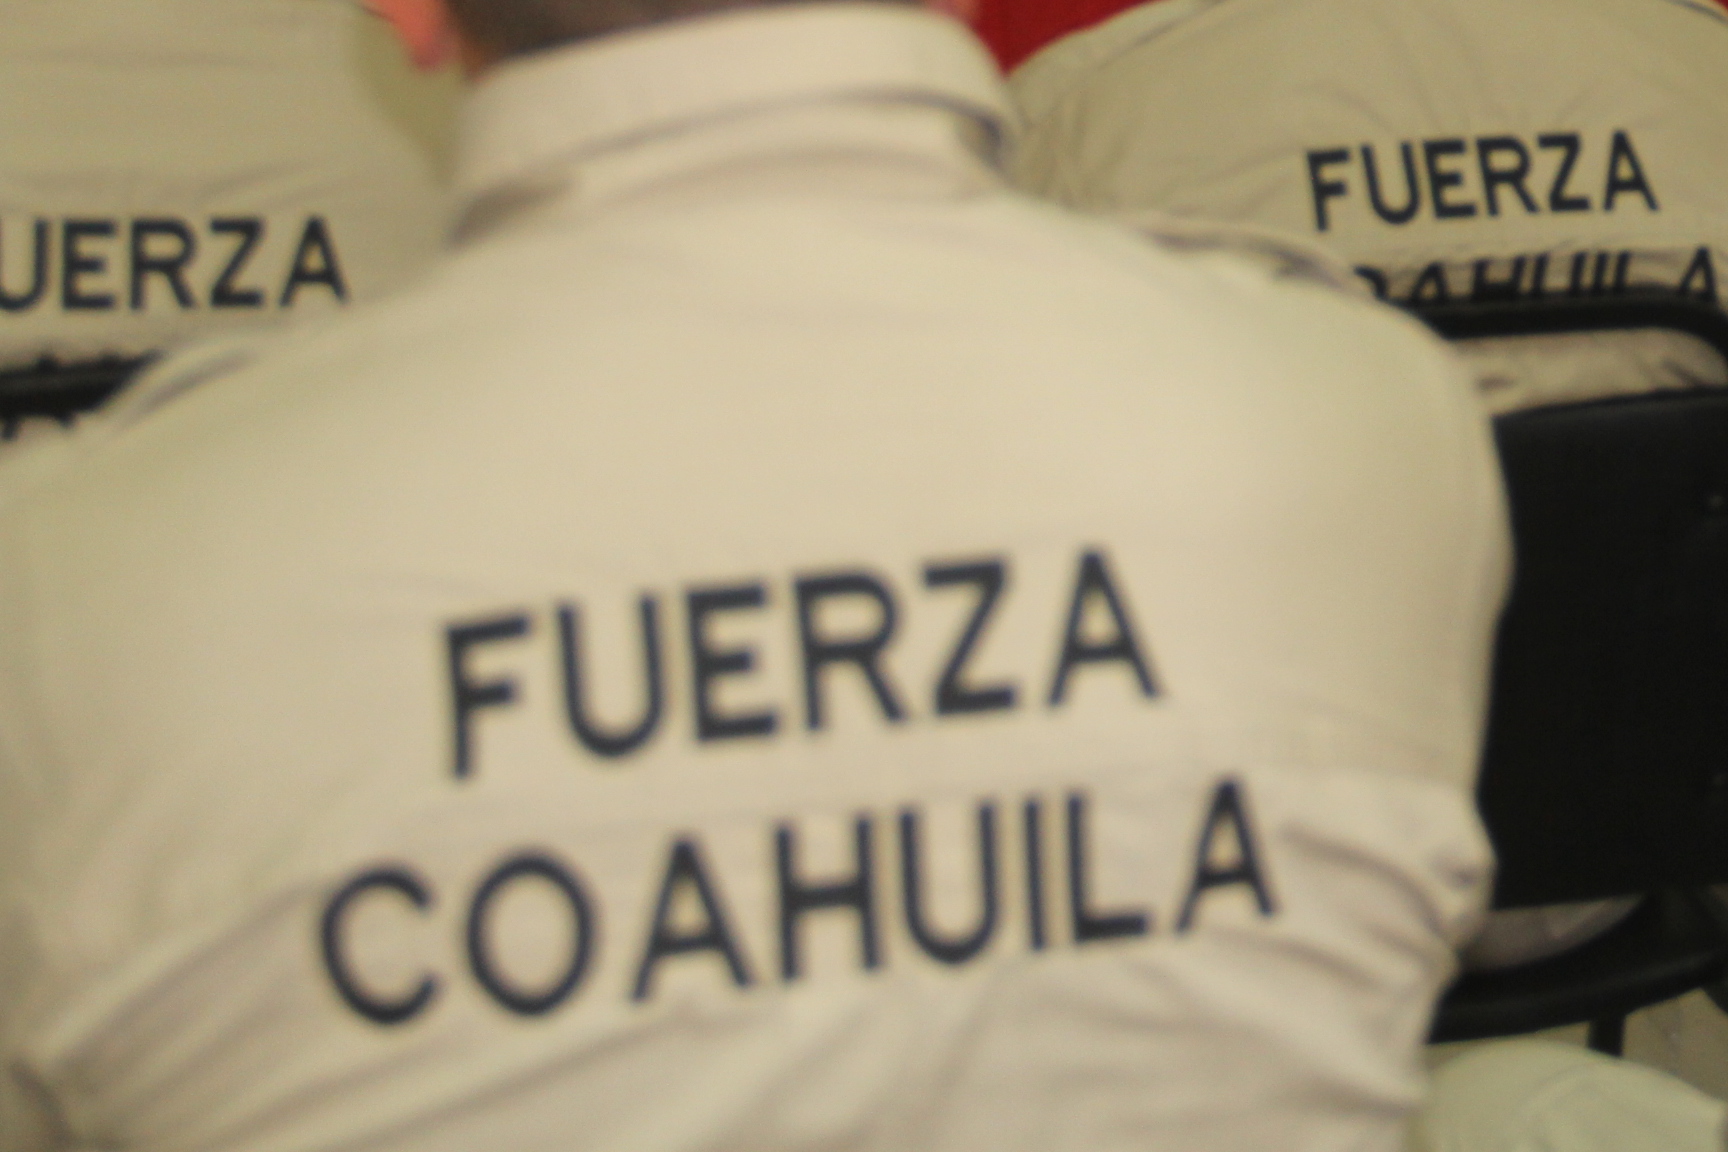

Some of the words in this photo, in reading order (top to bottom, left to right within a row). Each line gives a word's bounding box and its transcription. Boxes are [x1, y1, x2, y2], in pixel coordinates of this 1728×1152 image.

[0, 212, 352, 313] UERZA
[1306, 129, 1660, 233] FUERZA
[440, 545, 1163, 783] FUERZA
[317, 773, 1279, 1027] COAHUILA
